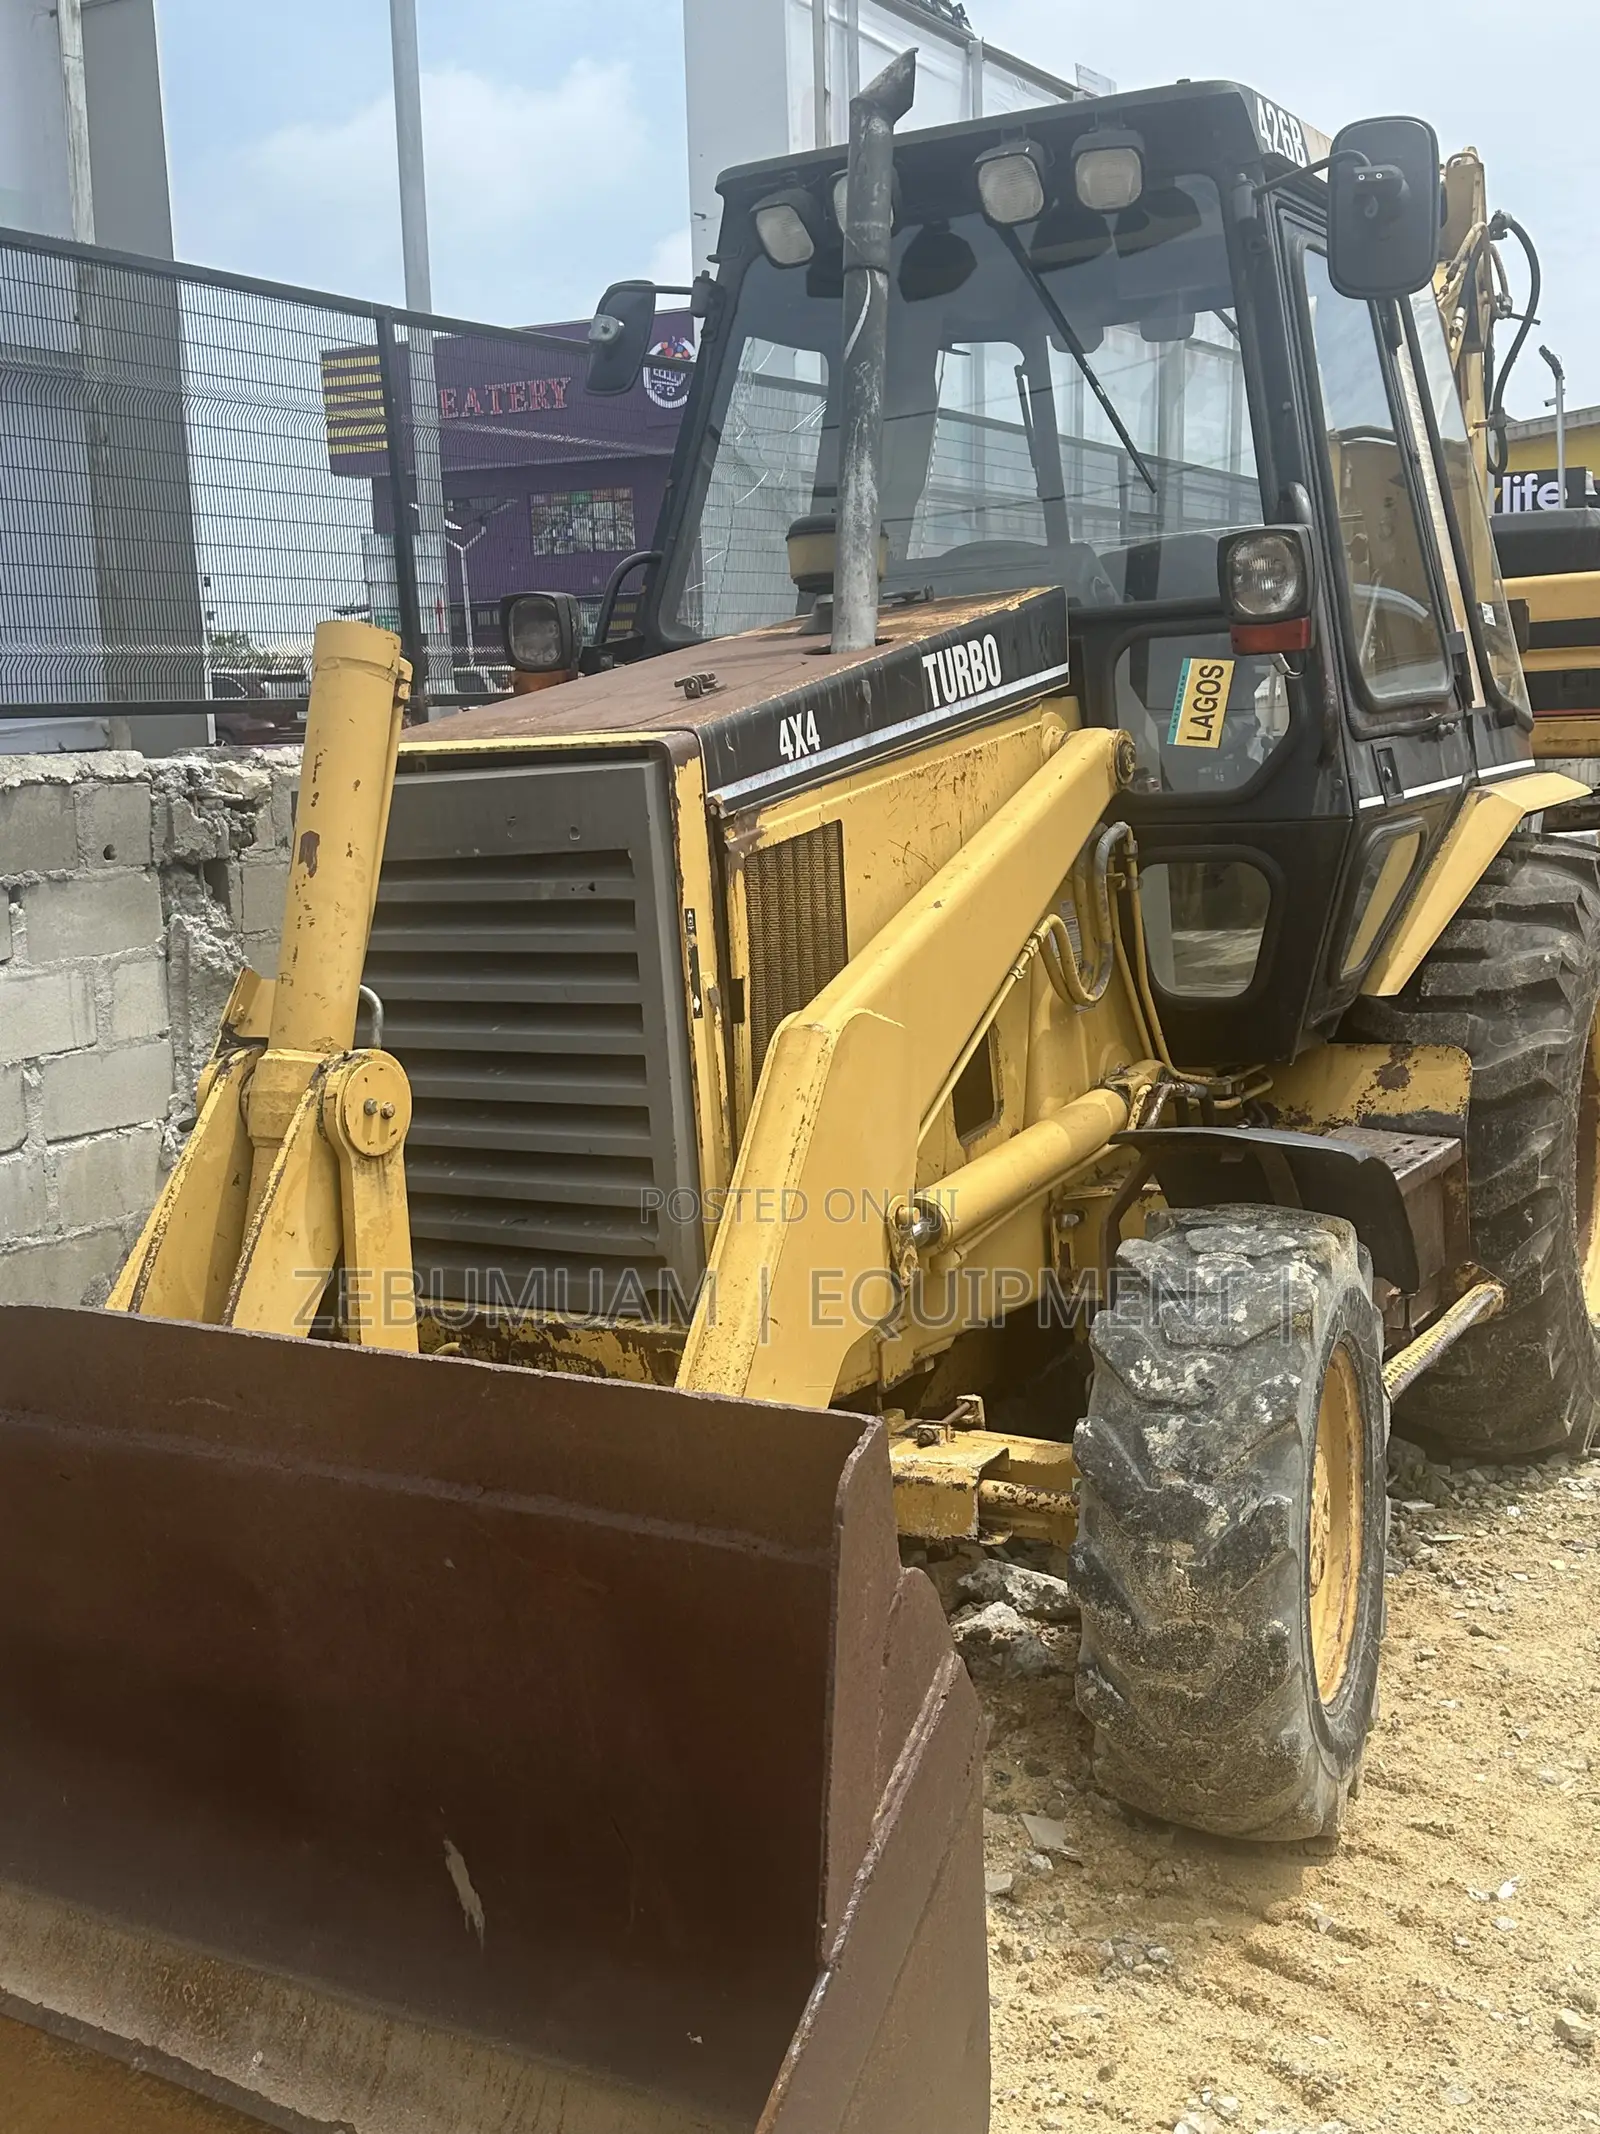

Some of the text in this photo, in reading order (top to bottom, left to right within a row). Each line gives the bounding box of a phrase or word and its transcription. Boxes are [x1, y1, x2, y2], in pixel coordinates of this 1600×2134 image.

[1256, 96, 1308, 169] 426B
[439, 377, 572, 419] EATERY
[1494, 472, 1569, 514] life
[921, 633, 1002, 708] TURBO
[1186, 665, 1225, 742] LAGOS
[778, 709, 821, 761] 4X4
